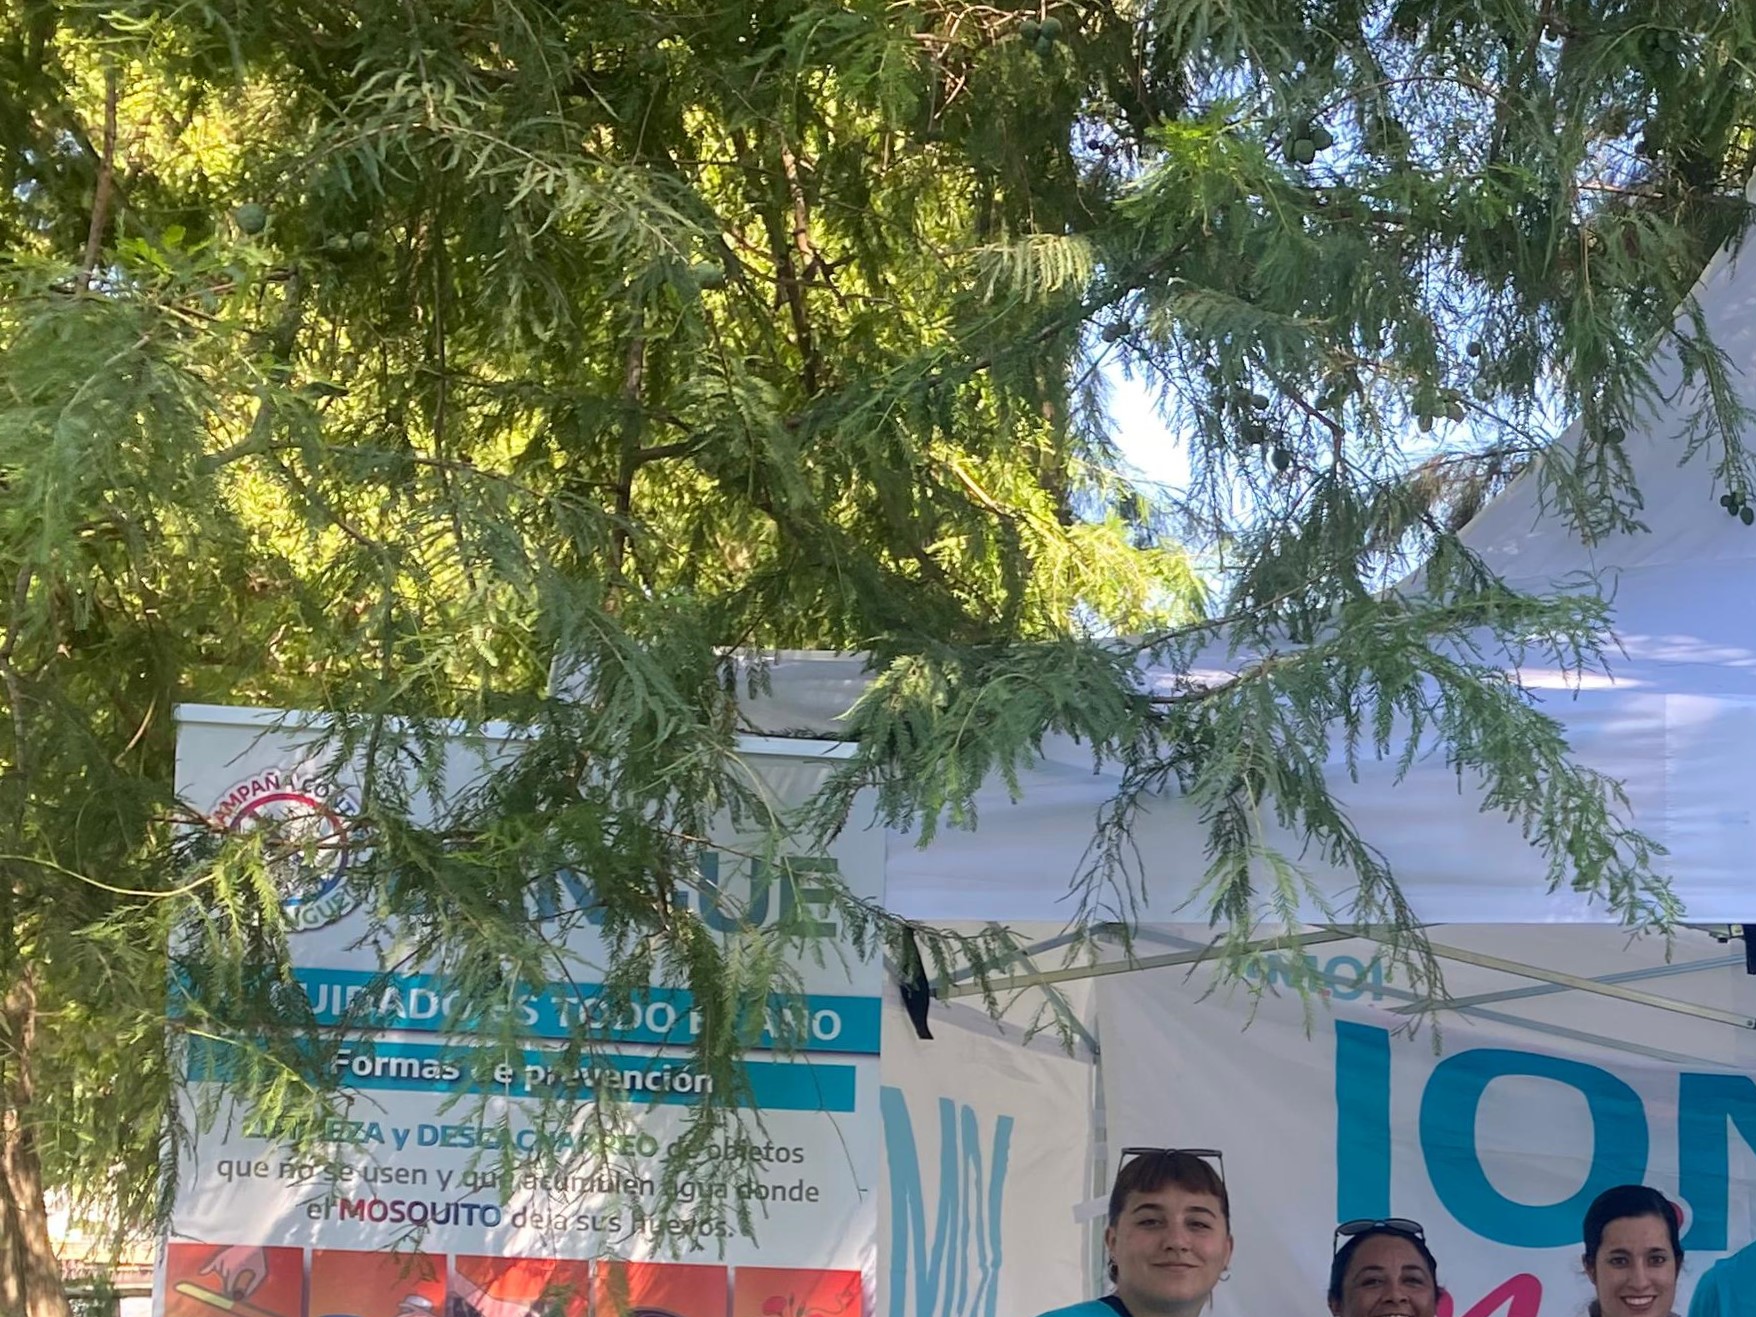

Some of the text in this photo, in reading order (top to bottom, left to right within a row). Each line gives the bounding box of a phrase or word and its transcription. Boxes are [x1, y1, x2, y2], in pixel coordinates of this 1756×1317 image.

[330, 1049, 460, 1080] Formas
[218, 1160, 269, 1182] que
[362, 1166, 427, 1184] usen
[436, 1169, 453, 1191] y
[339, 1199, 500, 1227] MOSQUITO
[576, 1215, 622, 1232] sus
